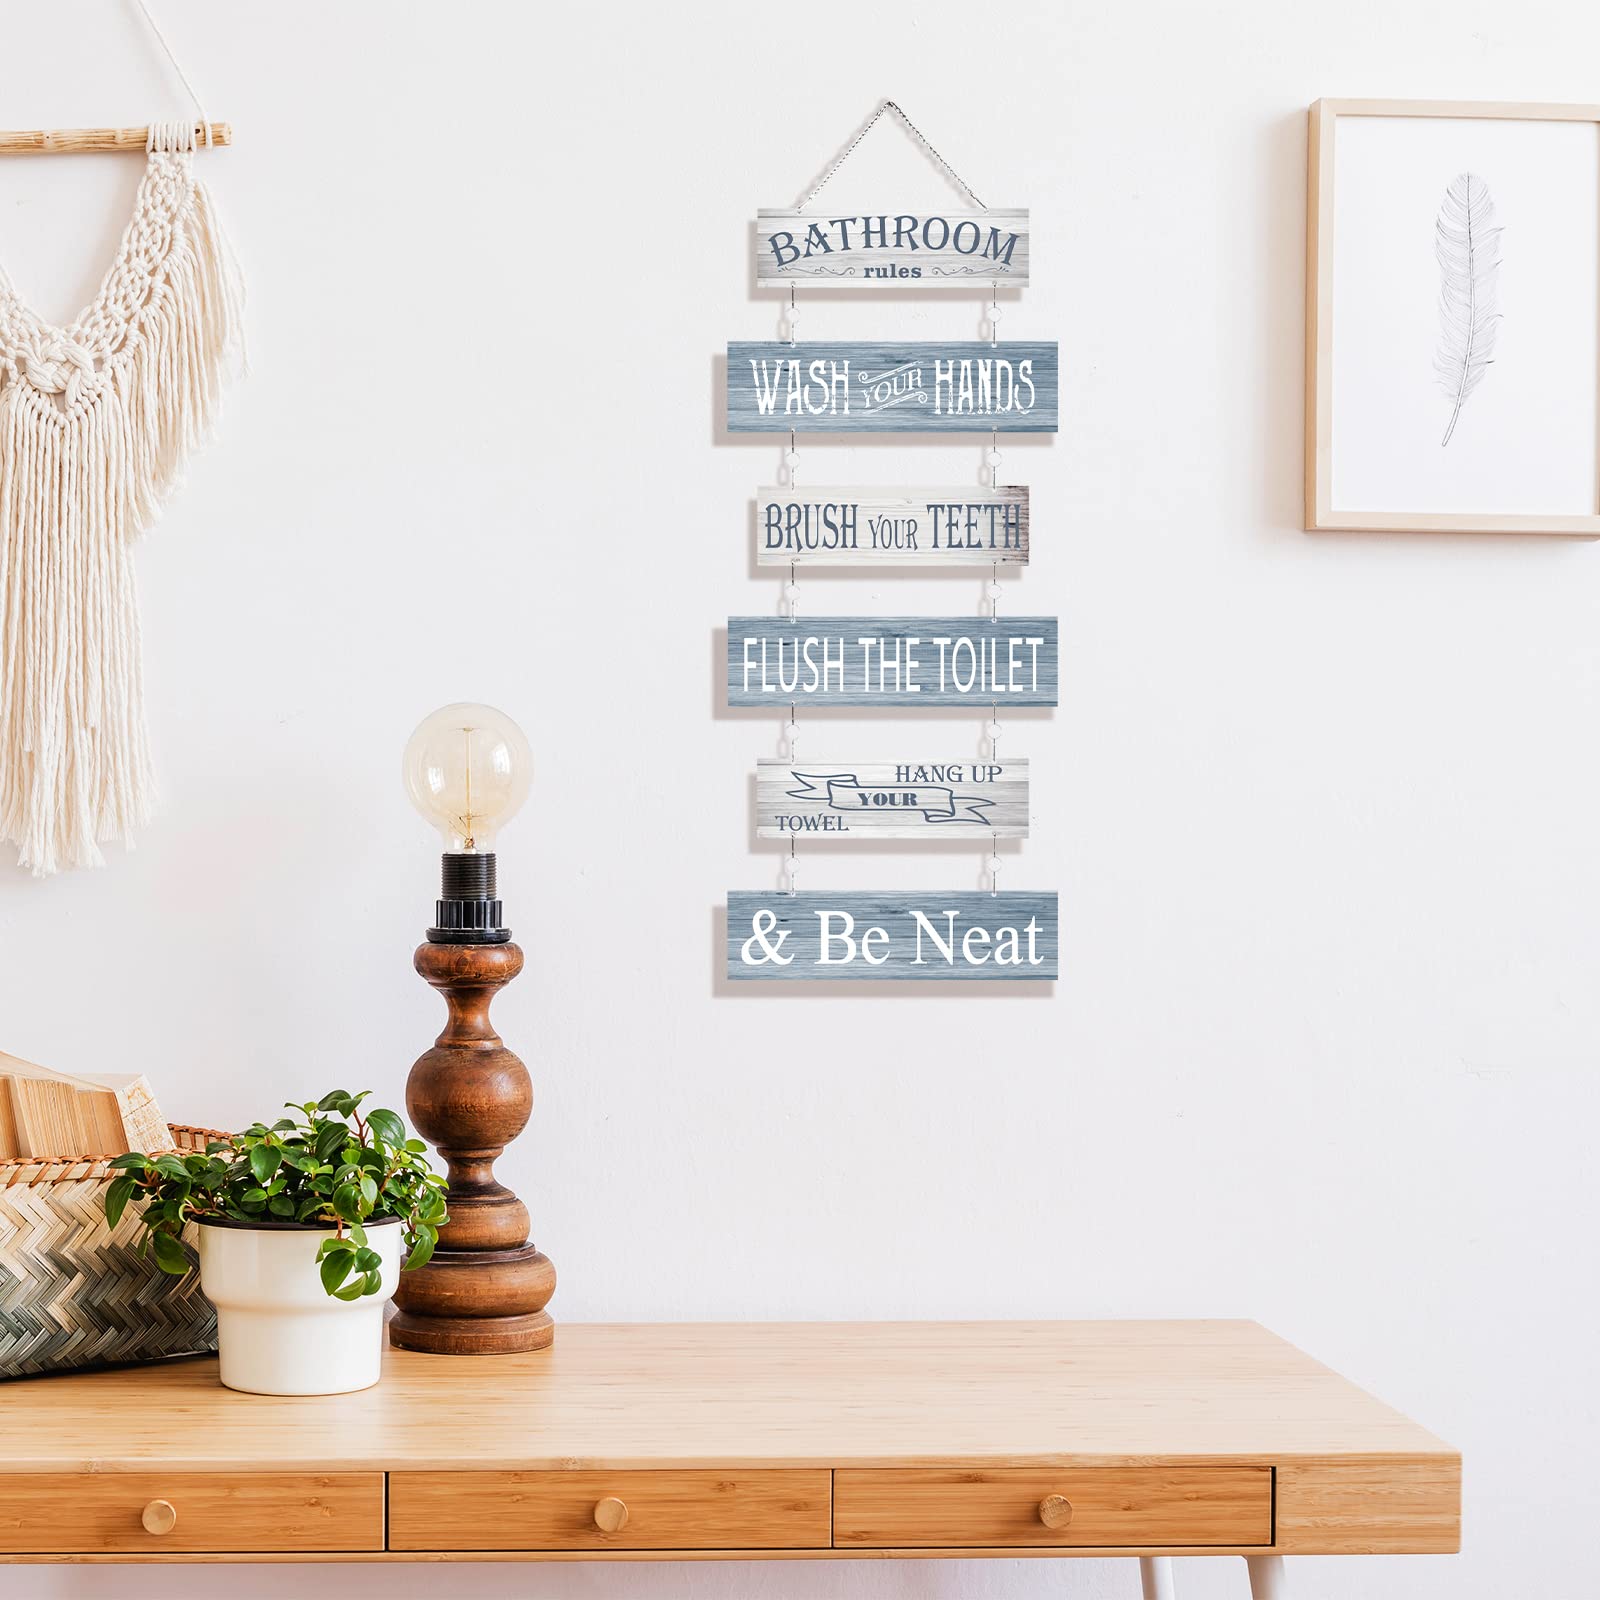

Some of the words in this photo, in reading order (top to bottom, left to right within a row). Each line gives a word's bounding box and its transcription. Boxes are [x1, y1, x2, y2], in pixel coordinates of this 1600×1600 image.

[768, 215, 1021, 267] BATHROOM
[864, 263, 922, 279] rules
[749, 359, 850, 415] WASH
[860, 367, 923, 408] YOUR
[934, 358, 1035, 415] HANDS
[765, 503, 859, 552] BRUSH
[868, 514, 918, 551] YOUR
[927, 503, 1021, 549] TEETH
[743, 637, 844, 692] FLUSH
[858, 637, 920, 692] THE
[933, 637, 1044, 692] TOILET
[895, 765, 962, 783] HANG
[971, 765, 1003, 783] UP
[775, 813, 849, 832] TOWEL
[857, 792, 918, 807] YOUR
[741, 909, 795, 965] &
[814, 910, 890, 965] Be
[909, 910, 1044, 965] Neat
